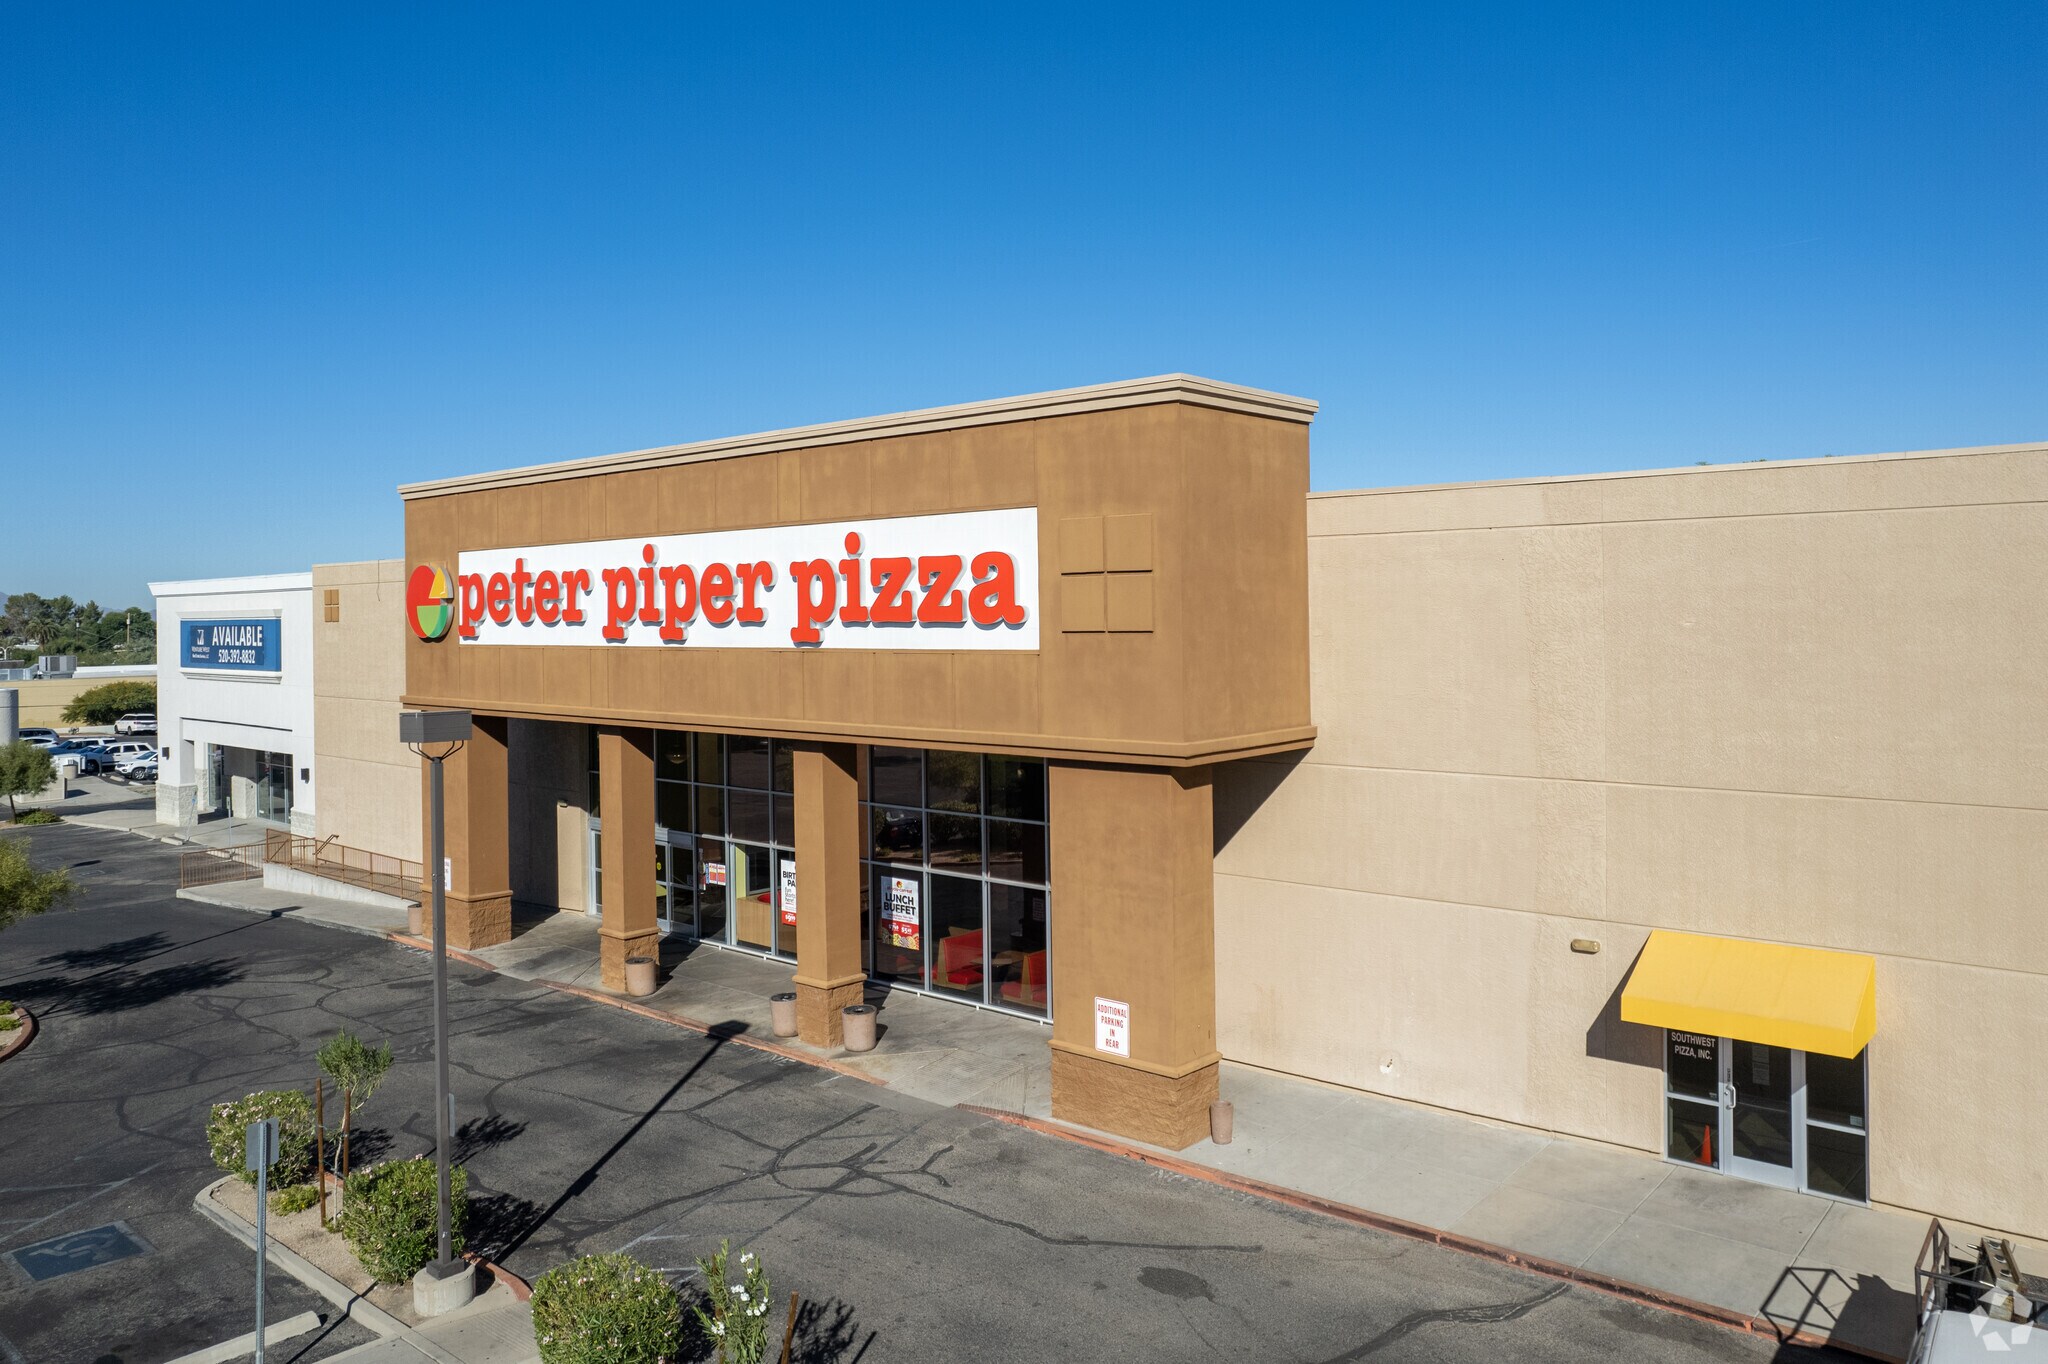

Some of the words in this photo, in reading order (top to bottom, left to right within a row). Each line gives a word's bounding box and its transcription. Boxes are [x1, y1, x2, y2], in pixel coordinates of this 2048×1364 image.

[458, 557, 594, 638] peter
[601, 543, 775, 642] piper
[789, 531, 1025, 645] pizza
[212, 625, 263, 647] AVAILABLE
[218, 649, 256, 664] 520-392-8832
[885, 892, 914, 906] LUNCH
[883, 901, 917, 916] BUFFET
[1097, 1004, 1127, 1018] ADDITIONAL
[1101, 1015, 1124, 1029] PARKING
[1110, 1029, 1115, 1037] IN
[1671, 1031, 1716, 1048] SOUTHWEST
[1106, 1039, 1119, 1049] REAR
[1674, 1045, 1697, 1059] PIZZA,
[1697, 1049, 1713, 1060] INC.
